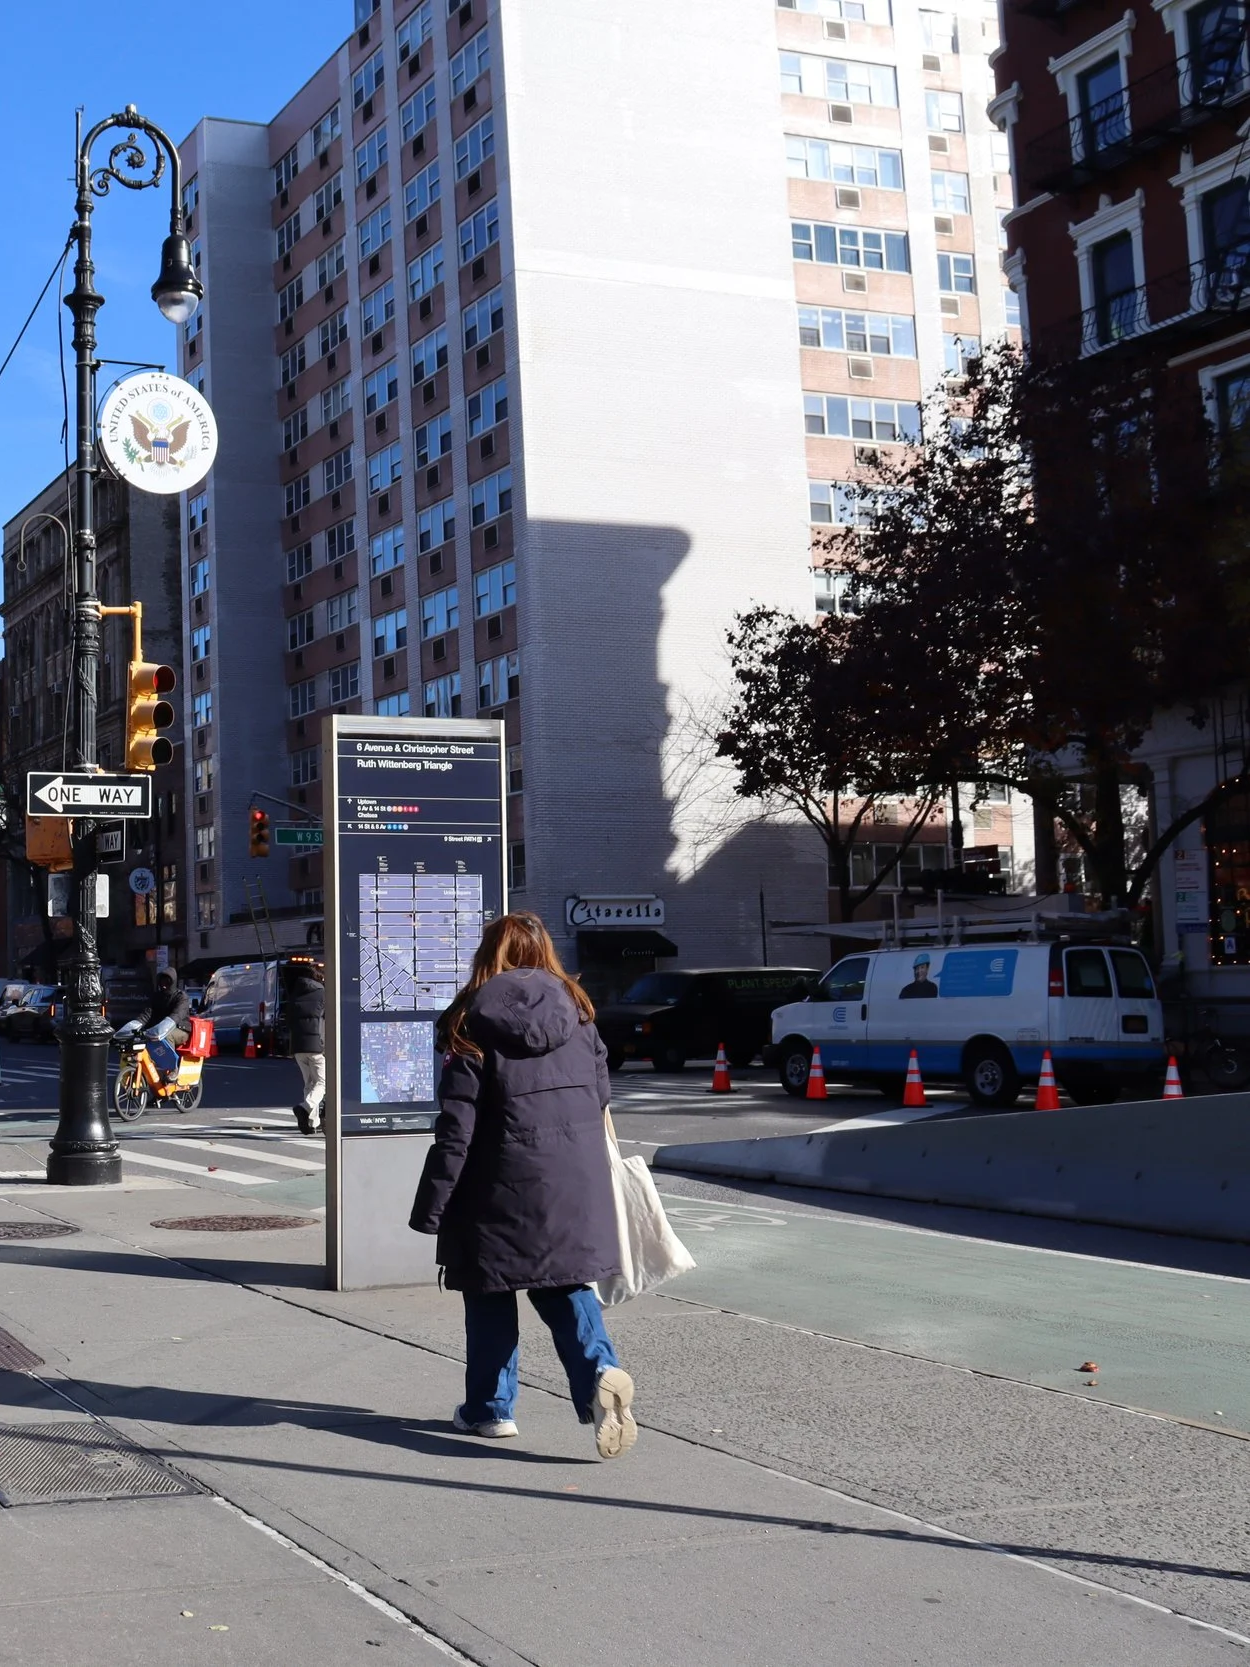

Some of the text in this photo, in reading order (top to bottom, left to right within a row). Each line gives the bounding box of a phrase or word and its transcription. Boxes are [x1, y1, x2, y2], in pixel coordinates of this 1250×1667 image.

[110, 383, 211, 451] UNITED STATES of AMERICA
[356, 743, 474, 755] 6 Avenue & Christopher Street
[357, 759, 453, 772] Ruth Wittenberg Triangle
[48, 787, 134, 803] ONE WAY
[104, 832, 119, 850] WAY
[296, 832, 303, 841] W
[306, 832, 311, 842] 9
[570, 899, 661, 925] Citarella
[727, 978, 760, 989] PLANT
